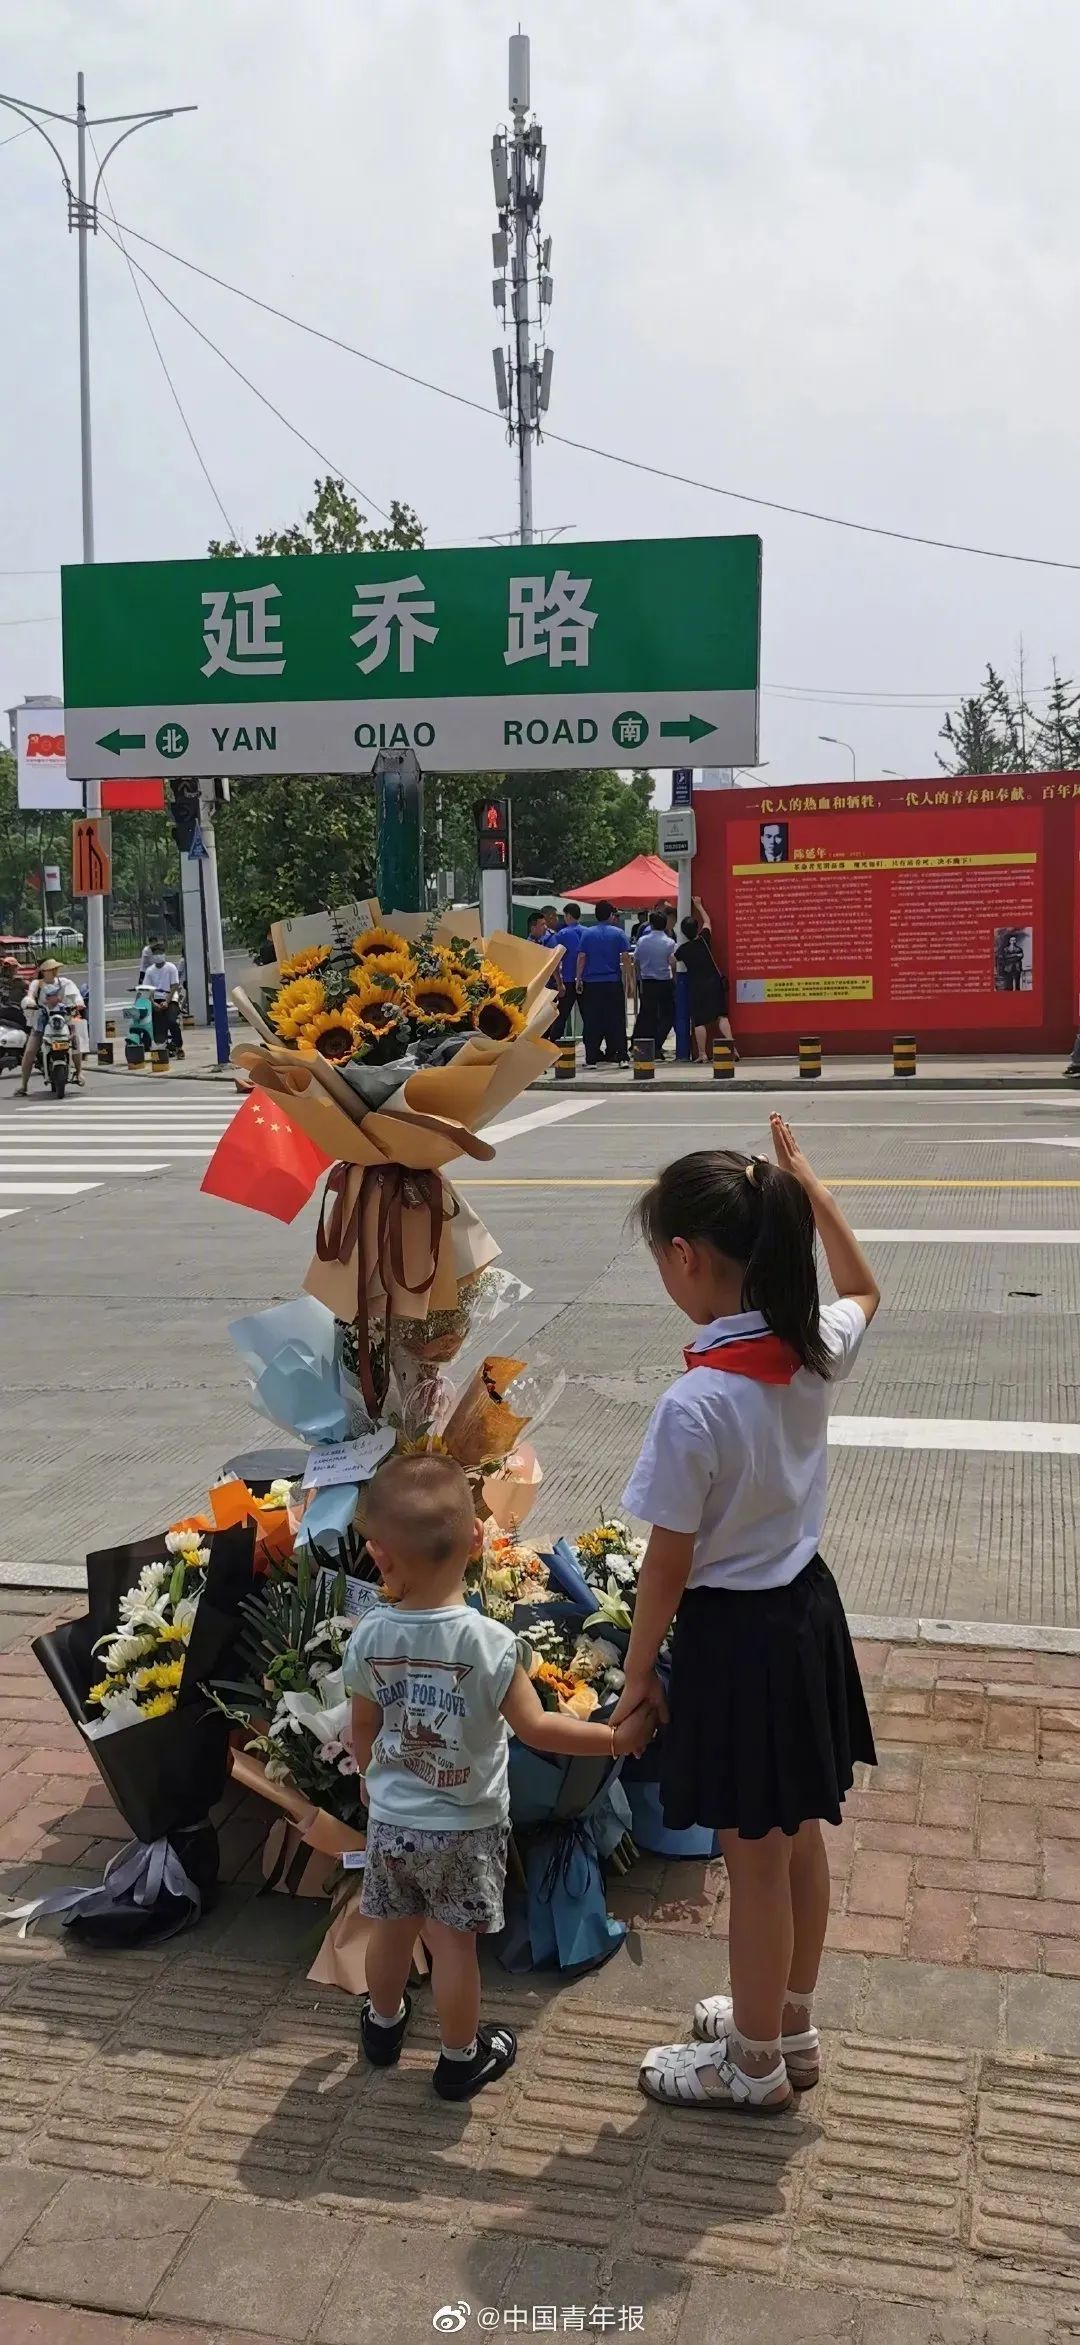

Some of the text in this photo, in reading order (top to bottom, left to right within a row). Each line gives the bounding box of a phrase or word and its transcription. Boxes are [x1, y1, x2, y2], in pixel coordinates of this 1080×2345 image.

[200, 570, 599, 679] 延乔路
[161, 729, 184, 752] 北
[211, 718, 599, 751] YAN QIAO ROAD
[618, 717, 642, 743] 南
[411, 1683, 437, 1707] FOR
[439, 1687, 467, 1717] LOVE
[437, 1766, 471, 1788] REEF
